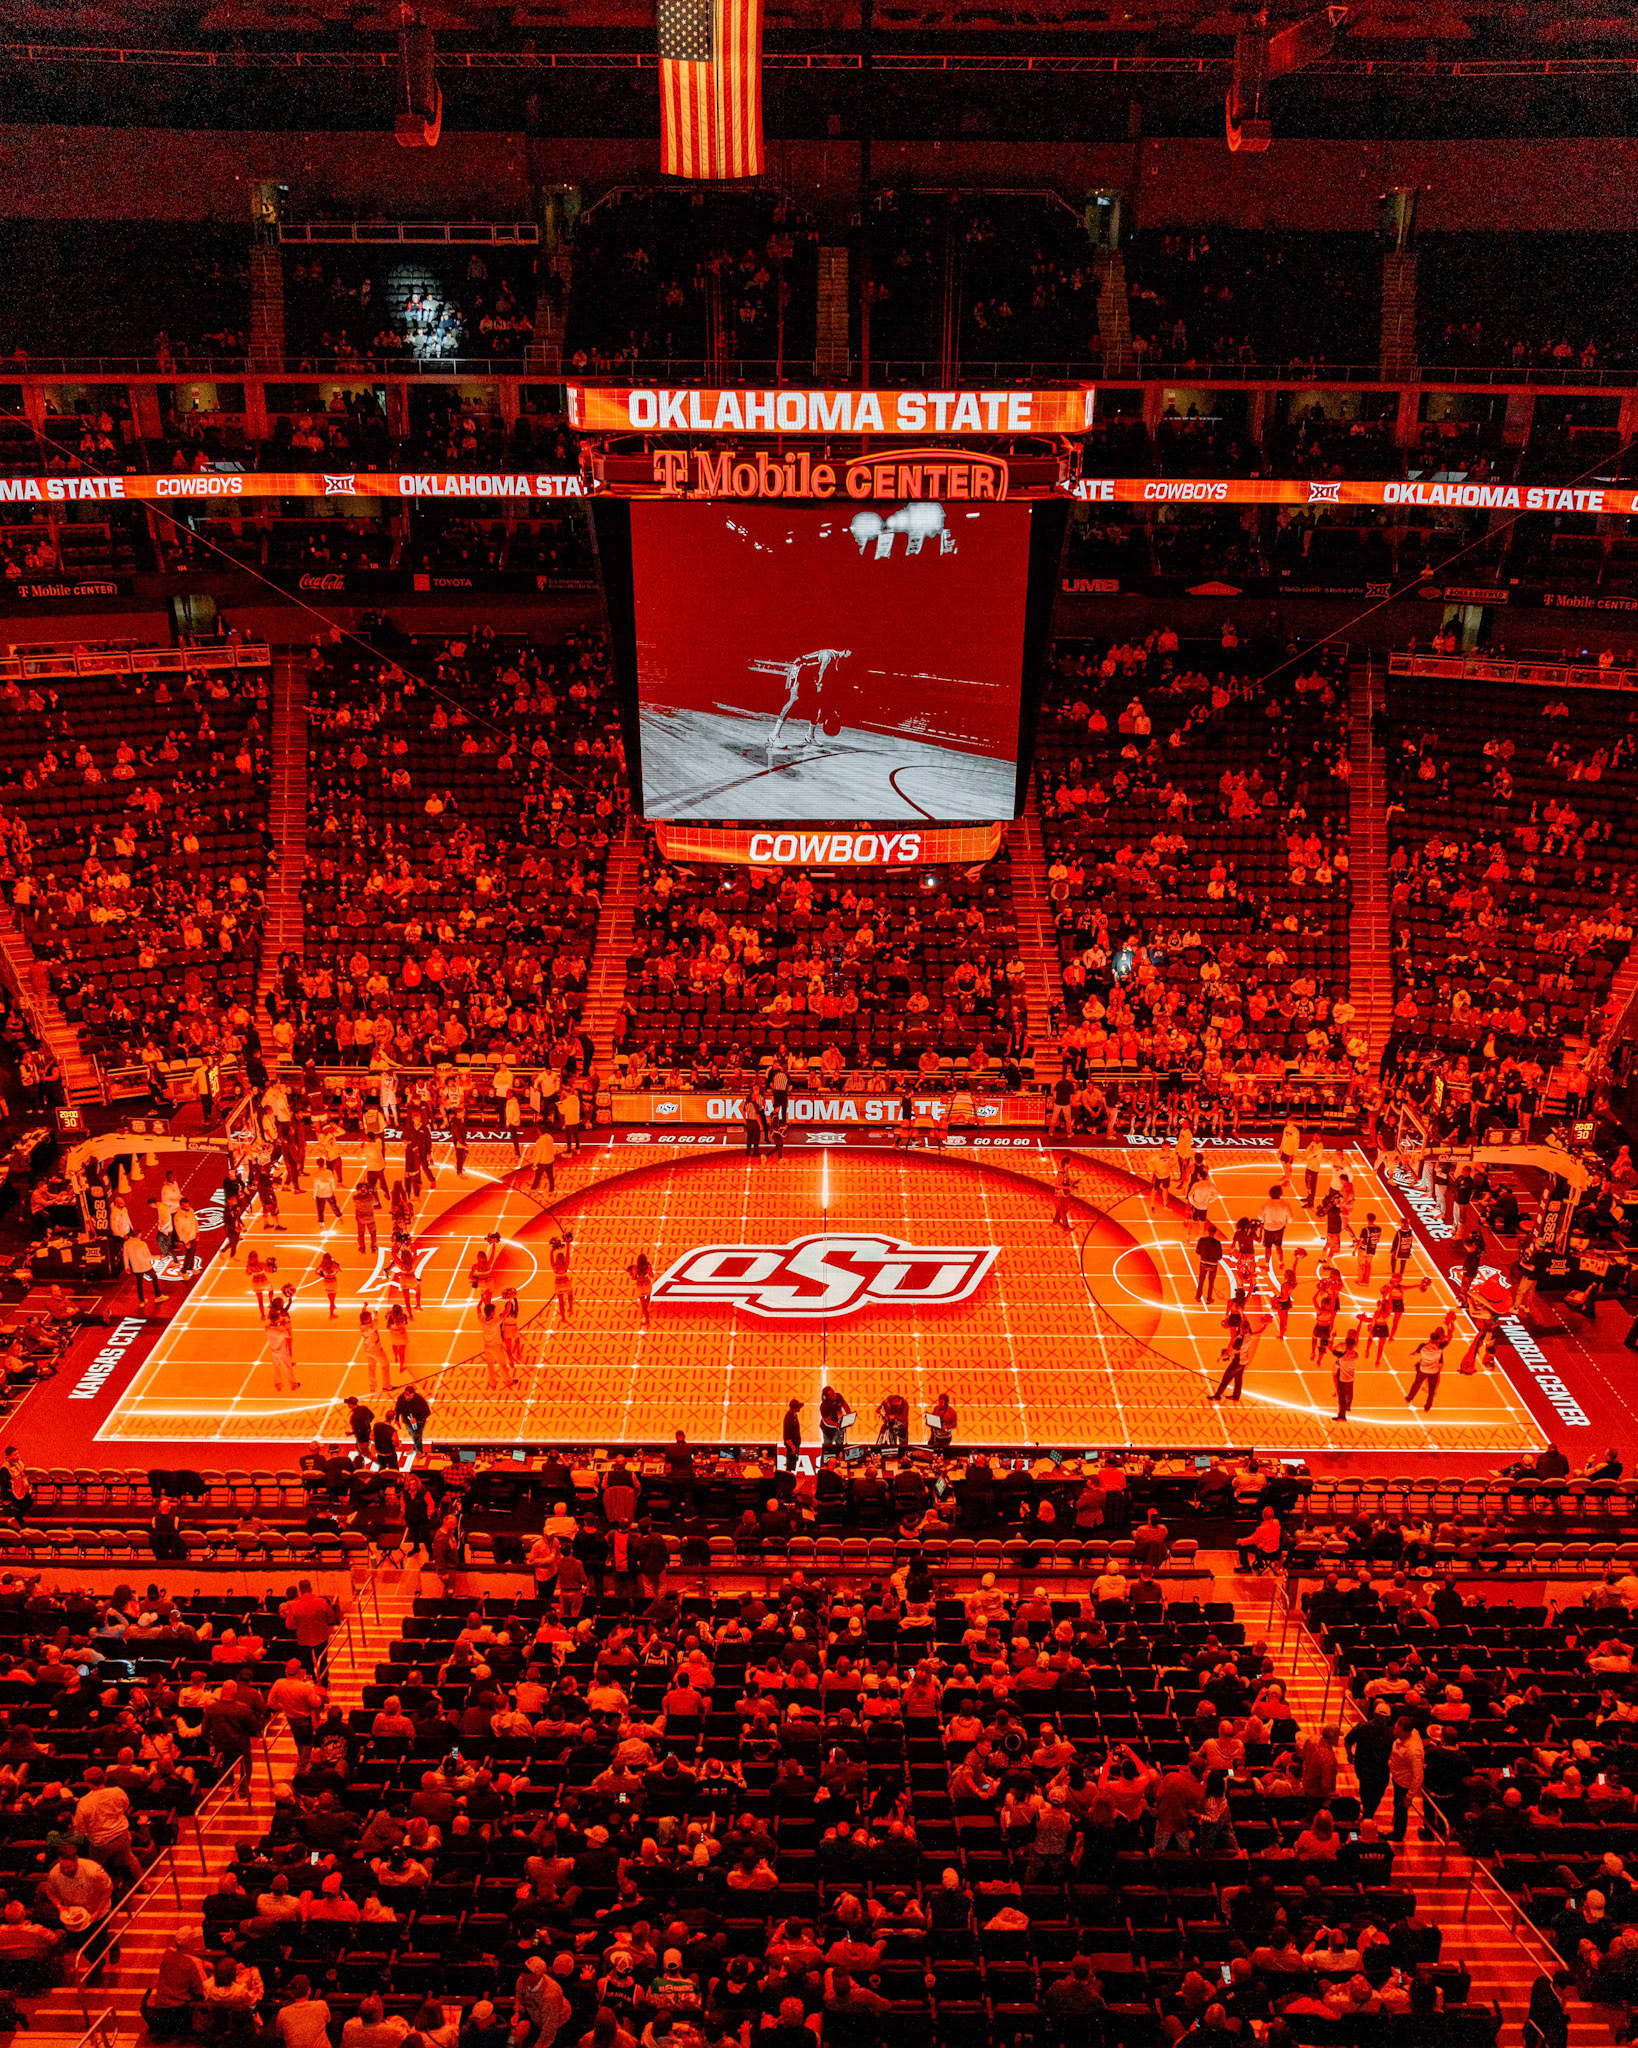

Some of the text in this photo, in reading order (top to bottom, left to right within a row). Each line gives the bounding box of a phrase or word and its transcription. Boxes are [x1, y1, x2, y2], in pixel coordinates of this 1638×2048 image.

[628, 389, 886, 431] OKLAHOMA
[896, 391, 1033, 431] STATE
[694, 450, 836, 499] Mobile
[845, 464, 997, 499] CENTER
[47, 477, 125, 499] STATE
[156, 476, 243, 496] COWBOYS
[399, 475, 532, 496] OKLAHOMA
[1143, 482, 1228, 500] COWBOYS
[1383, 483, 1520, 508] OKLAHOMA
[1526, 488, 1605, 511] STATE
[433, 577, 473, 587] TOYOTA
[1061, 578, 1120, 593] UMB
[31, 584, 71, 597] Mobile
[73, 585, 114, 596] CENTER
[1556, 594, 1595, 608] Mobile
[1597, 599, 1638, 611] CENTER
[748, 833, 922, 863] COWBOYS
[59, 1110, 78, 1118] 20:00
[64, 1118, 77, 1128] 30
[1574, 1123, 1593, 1131] 20:00
[657, 1135, 716, 1143] GO GO GO
[973, 1137, 991, 1145] GO
[1013, 1138, 1031, 1146] GO
[1576, 1130, 1589, 1140] 30
[94, 1199, 106, 1210] GO
[96, 1209, 107, 1220] GO
[1545, 1212, 1559, 1223] GO
[97, 1219, 109, 1230] GO
[1543, 1222, 1556, 1233] GO
[650, 1232, 1002, 1319] OSU
[67, 1316, 148, 1399] KANSAS CITY
[1497, 1314, 1592, 1427] T-MOBILE CENTER
